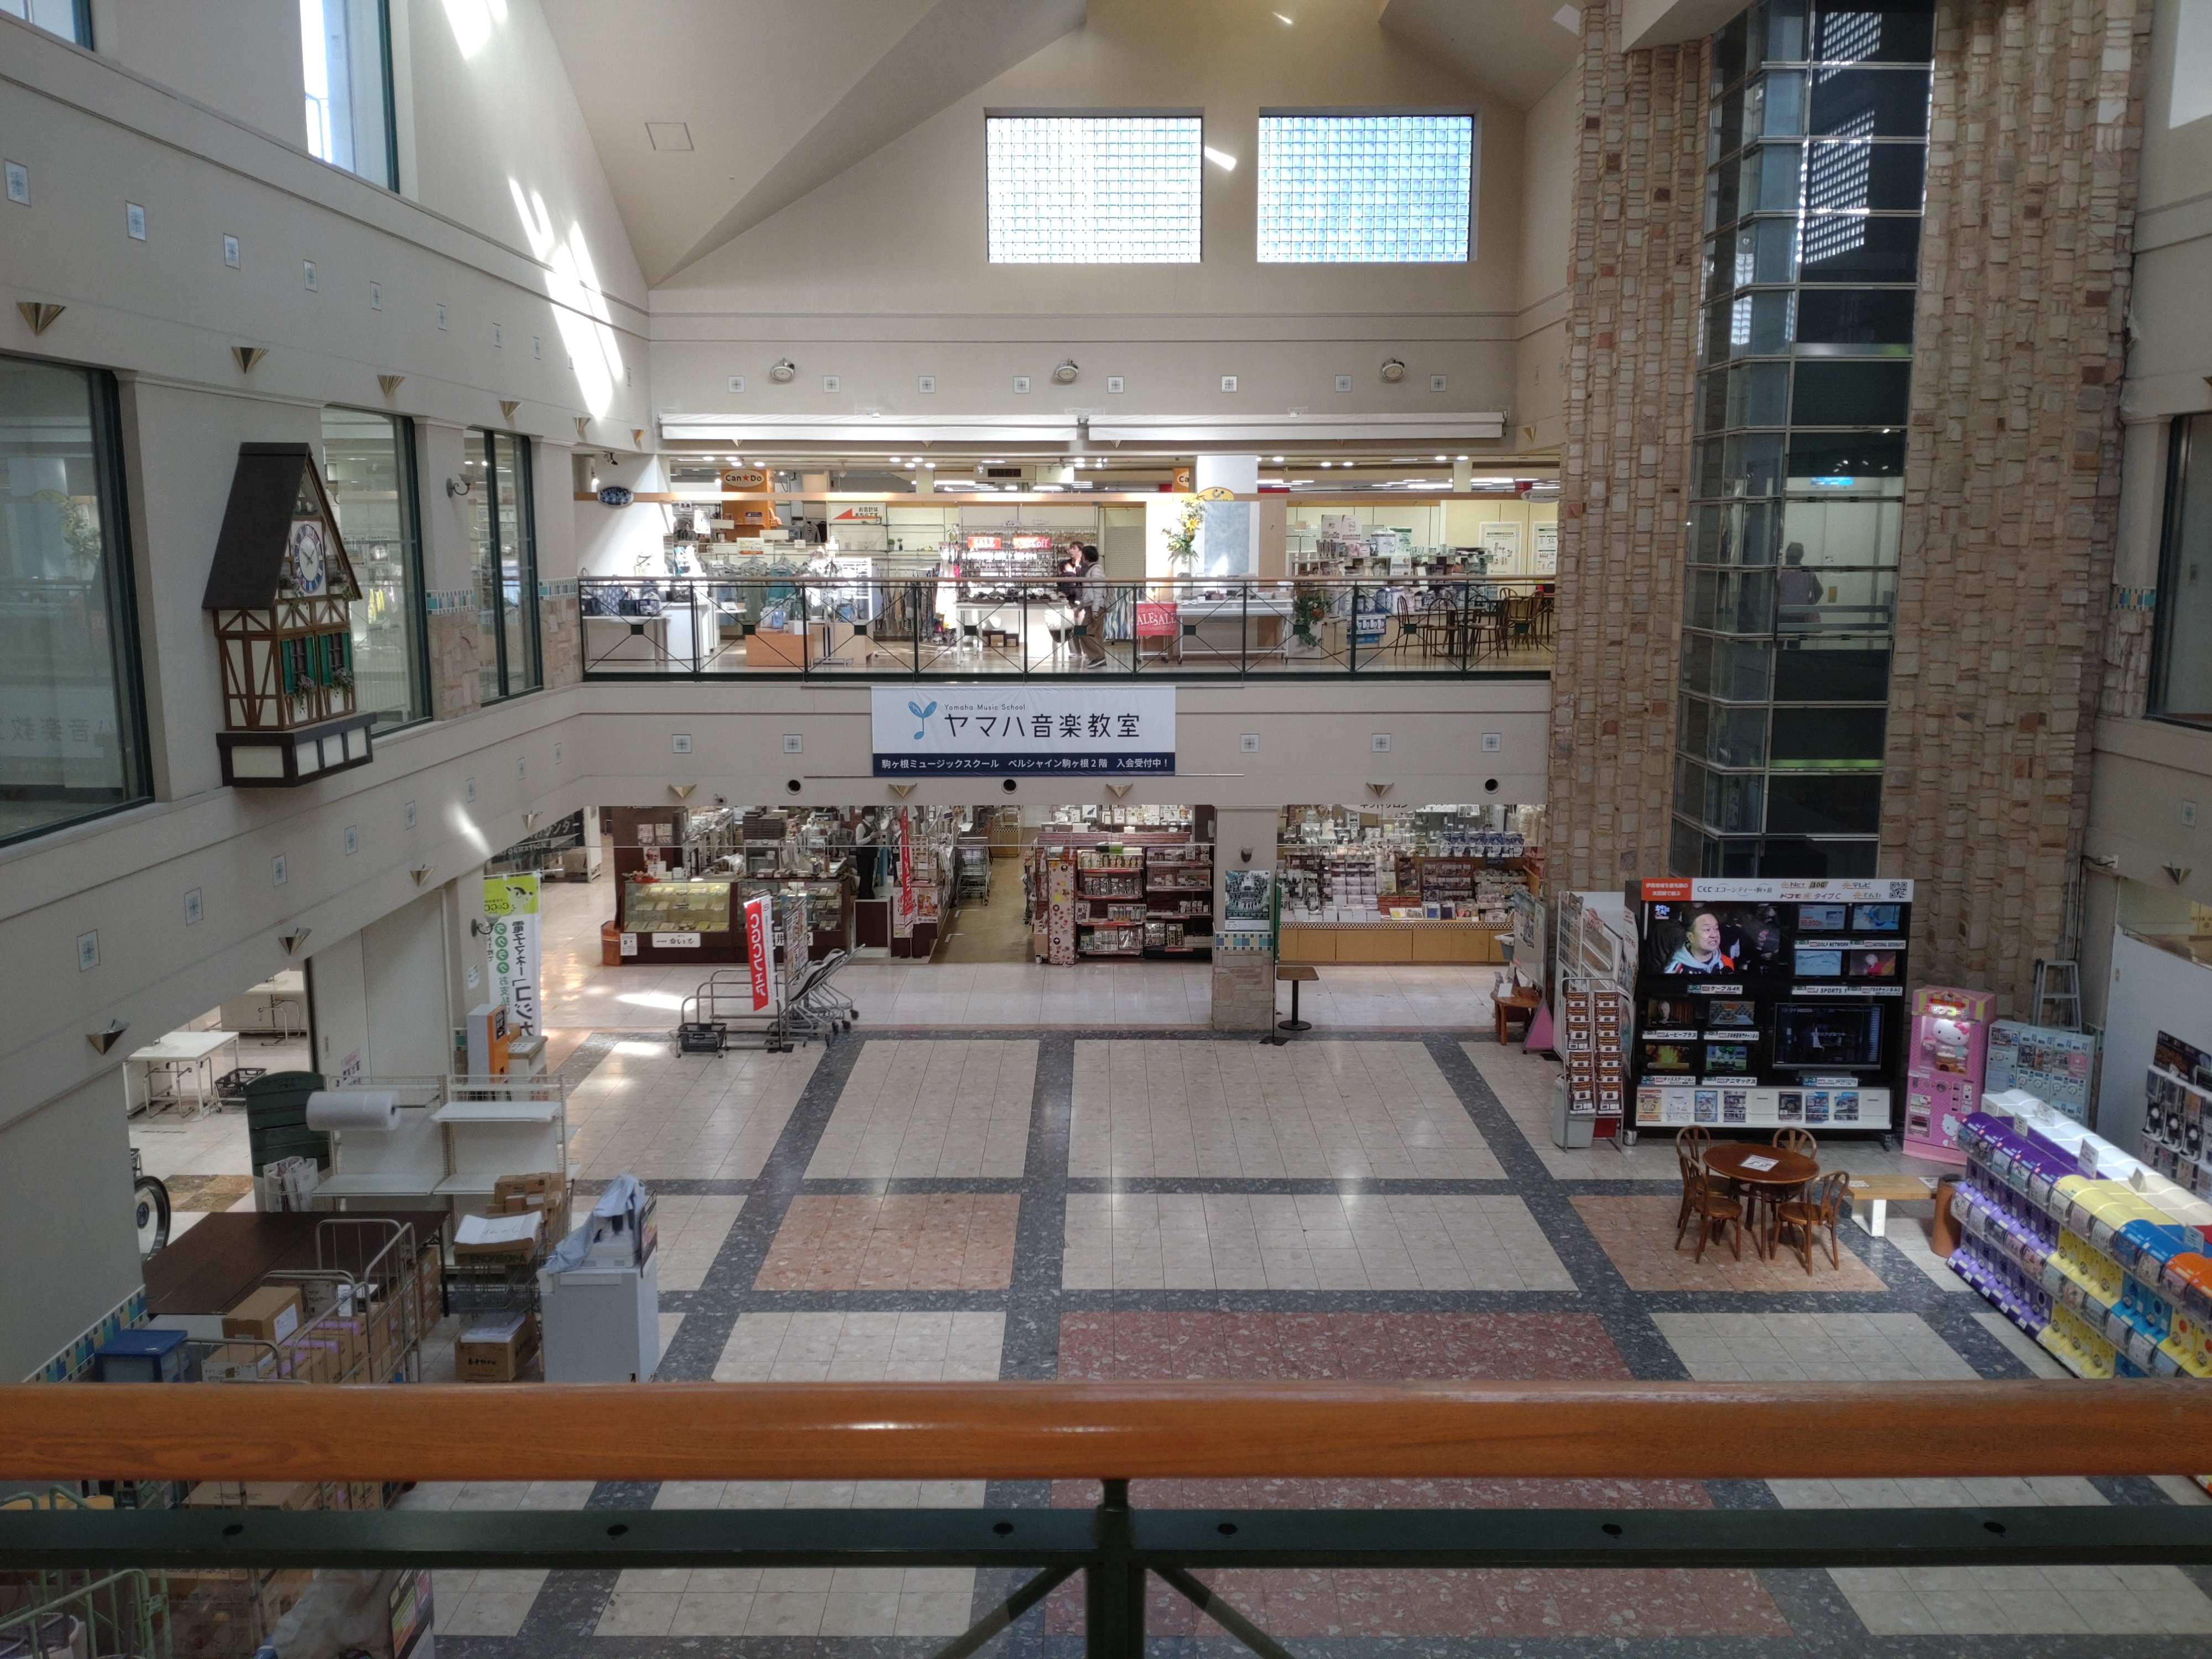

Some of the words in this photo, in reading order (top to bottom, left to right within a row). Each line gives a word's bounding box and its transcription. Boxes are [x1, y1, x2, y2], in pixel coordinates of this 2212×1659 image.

[944, 713, 1140, 738] ヤマハ音楽教室
[881, 759, 999, 769] 駒ヶ根ミュージックスクール
